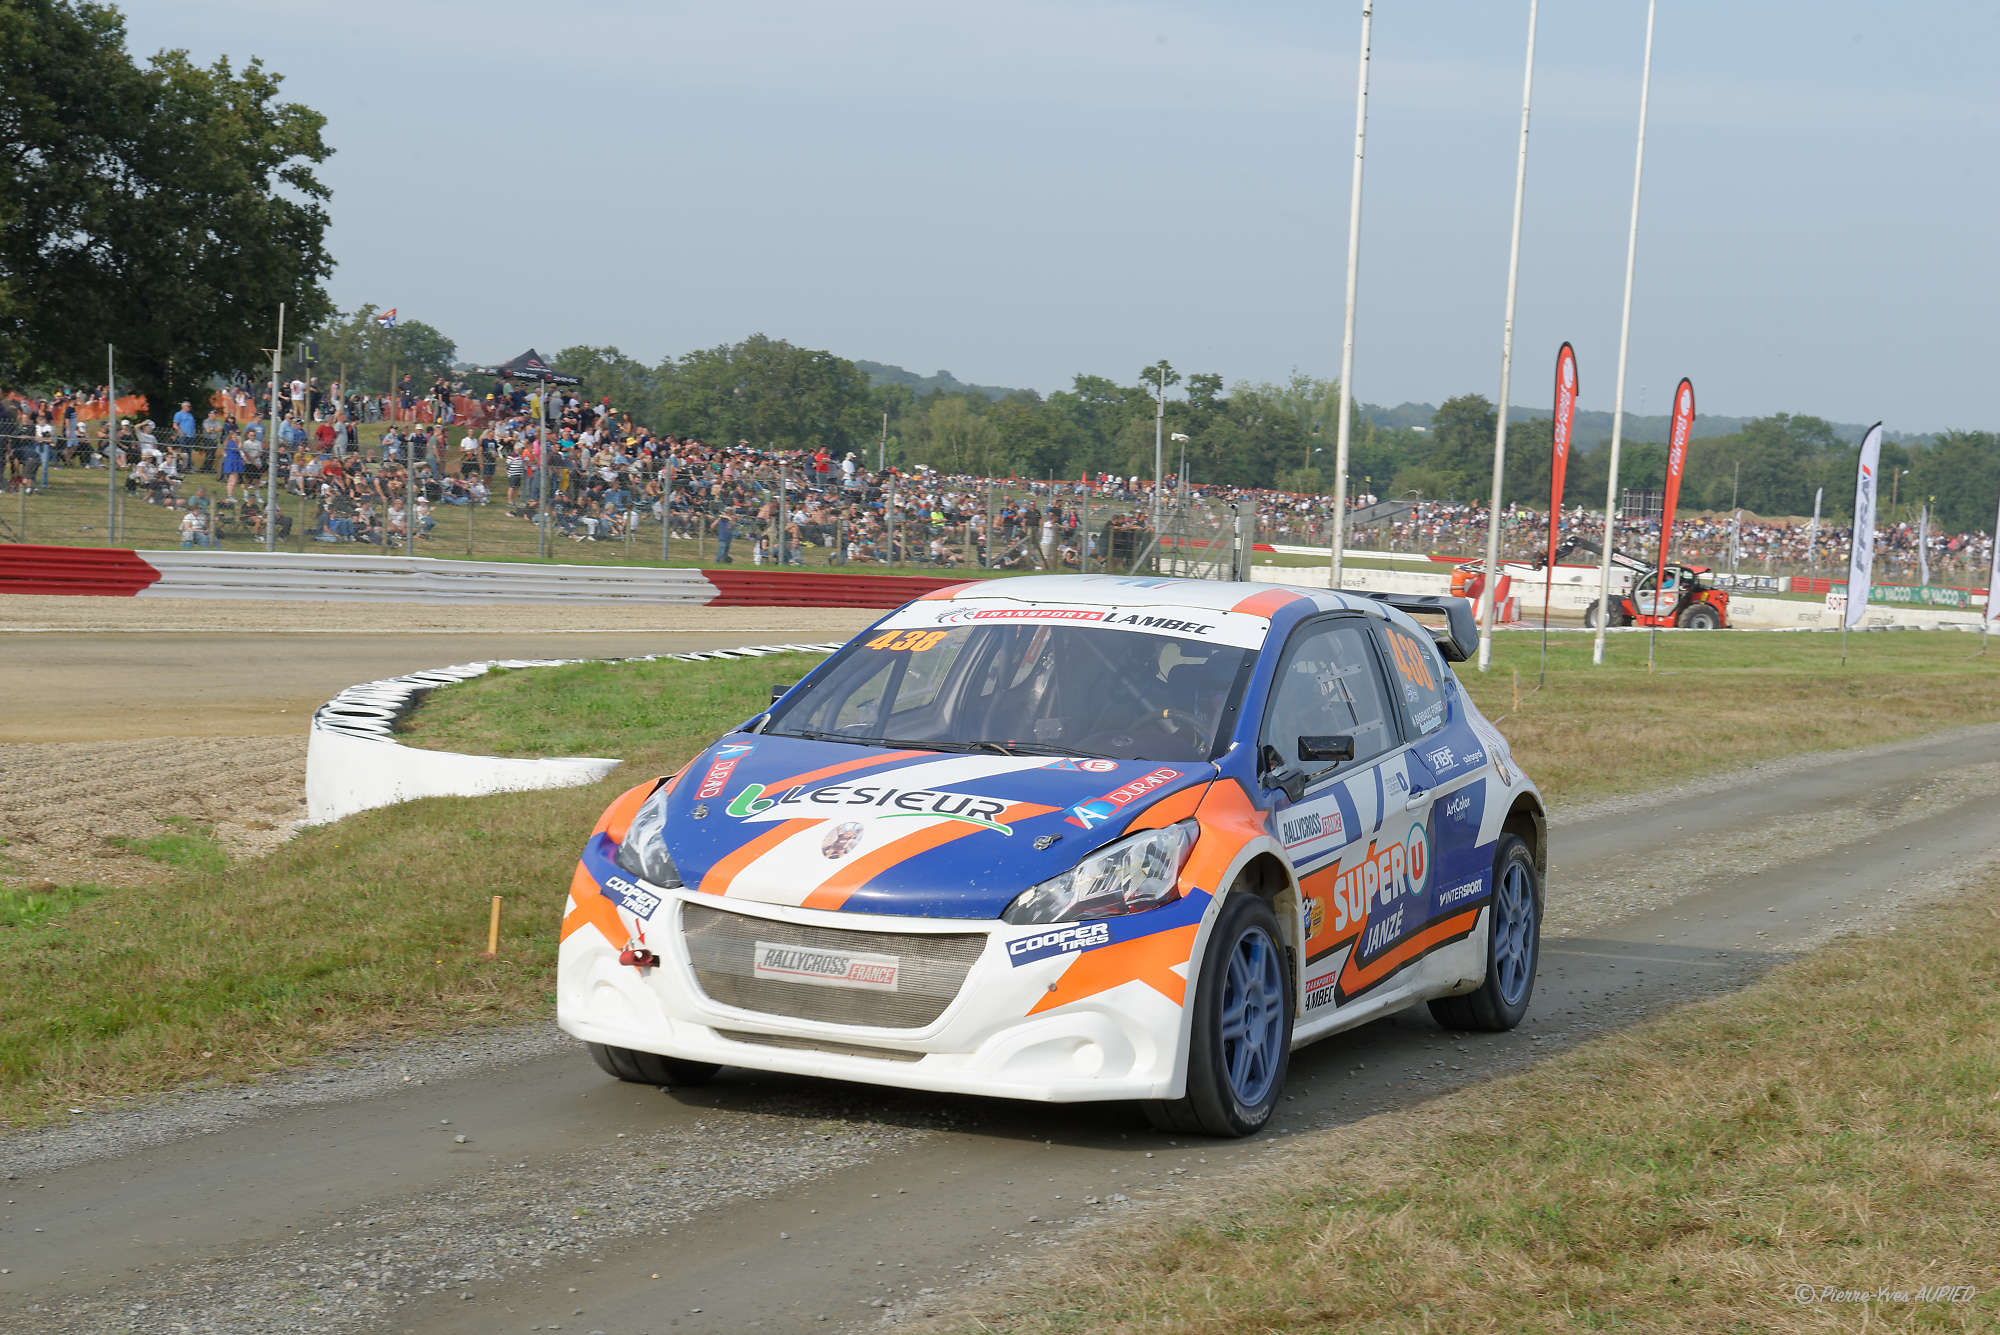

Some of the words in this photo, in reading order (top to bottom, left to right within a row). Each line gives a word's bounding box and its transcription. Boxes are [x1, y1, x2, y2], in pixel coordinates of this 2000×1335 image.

[977, 609, 1102, 620] TRANSPORTS
[1103, 612, 1215, 635] LAMBEC
[865, 630, 948, 651] 438
[1385, 627, 1435, 692] 438
[700, 761, 735, 798] DURAND
[1109, 769, 1178, 803] DURAND
[779, 786, 1005, 821] LESIEUR
[1283, 812, 1322, 845] RALLYCROSS
[605, 876, 660, 909] COOPER
[1334, 847, 1406, 932] SUPER
[621, 896, 651, 917] TIRES
[1010, 922, 1108, 955] COOPER
[1059, 934, 1109, 951] TIRES
[1364, 903, 1403, 957] JANZÉ
[763, 949, 850, 975] RALLYCROSS
[850, 964, 895, 984] FRANCE
[1305, 985, 1334, 1011] AMBEC
